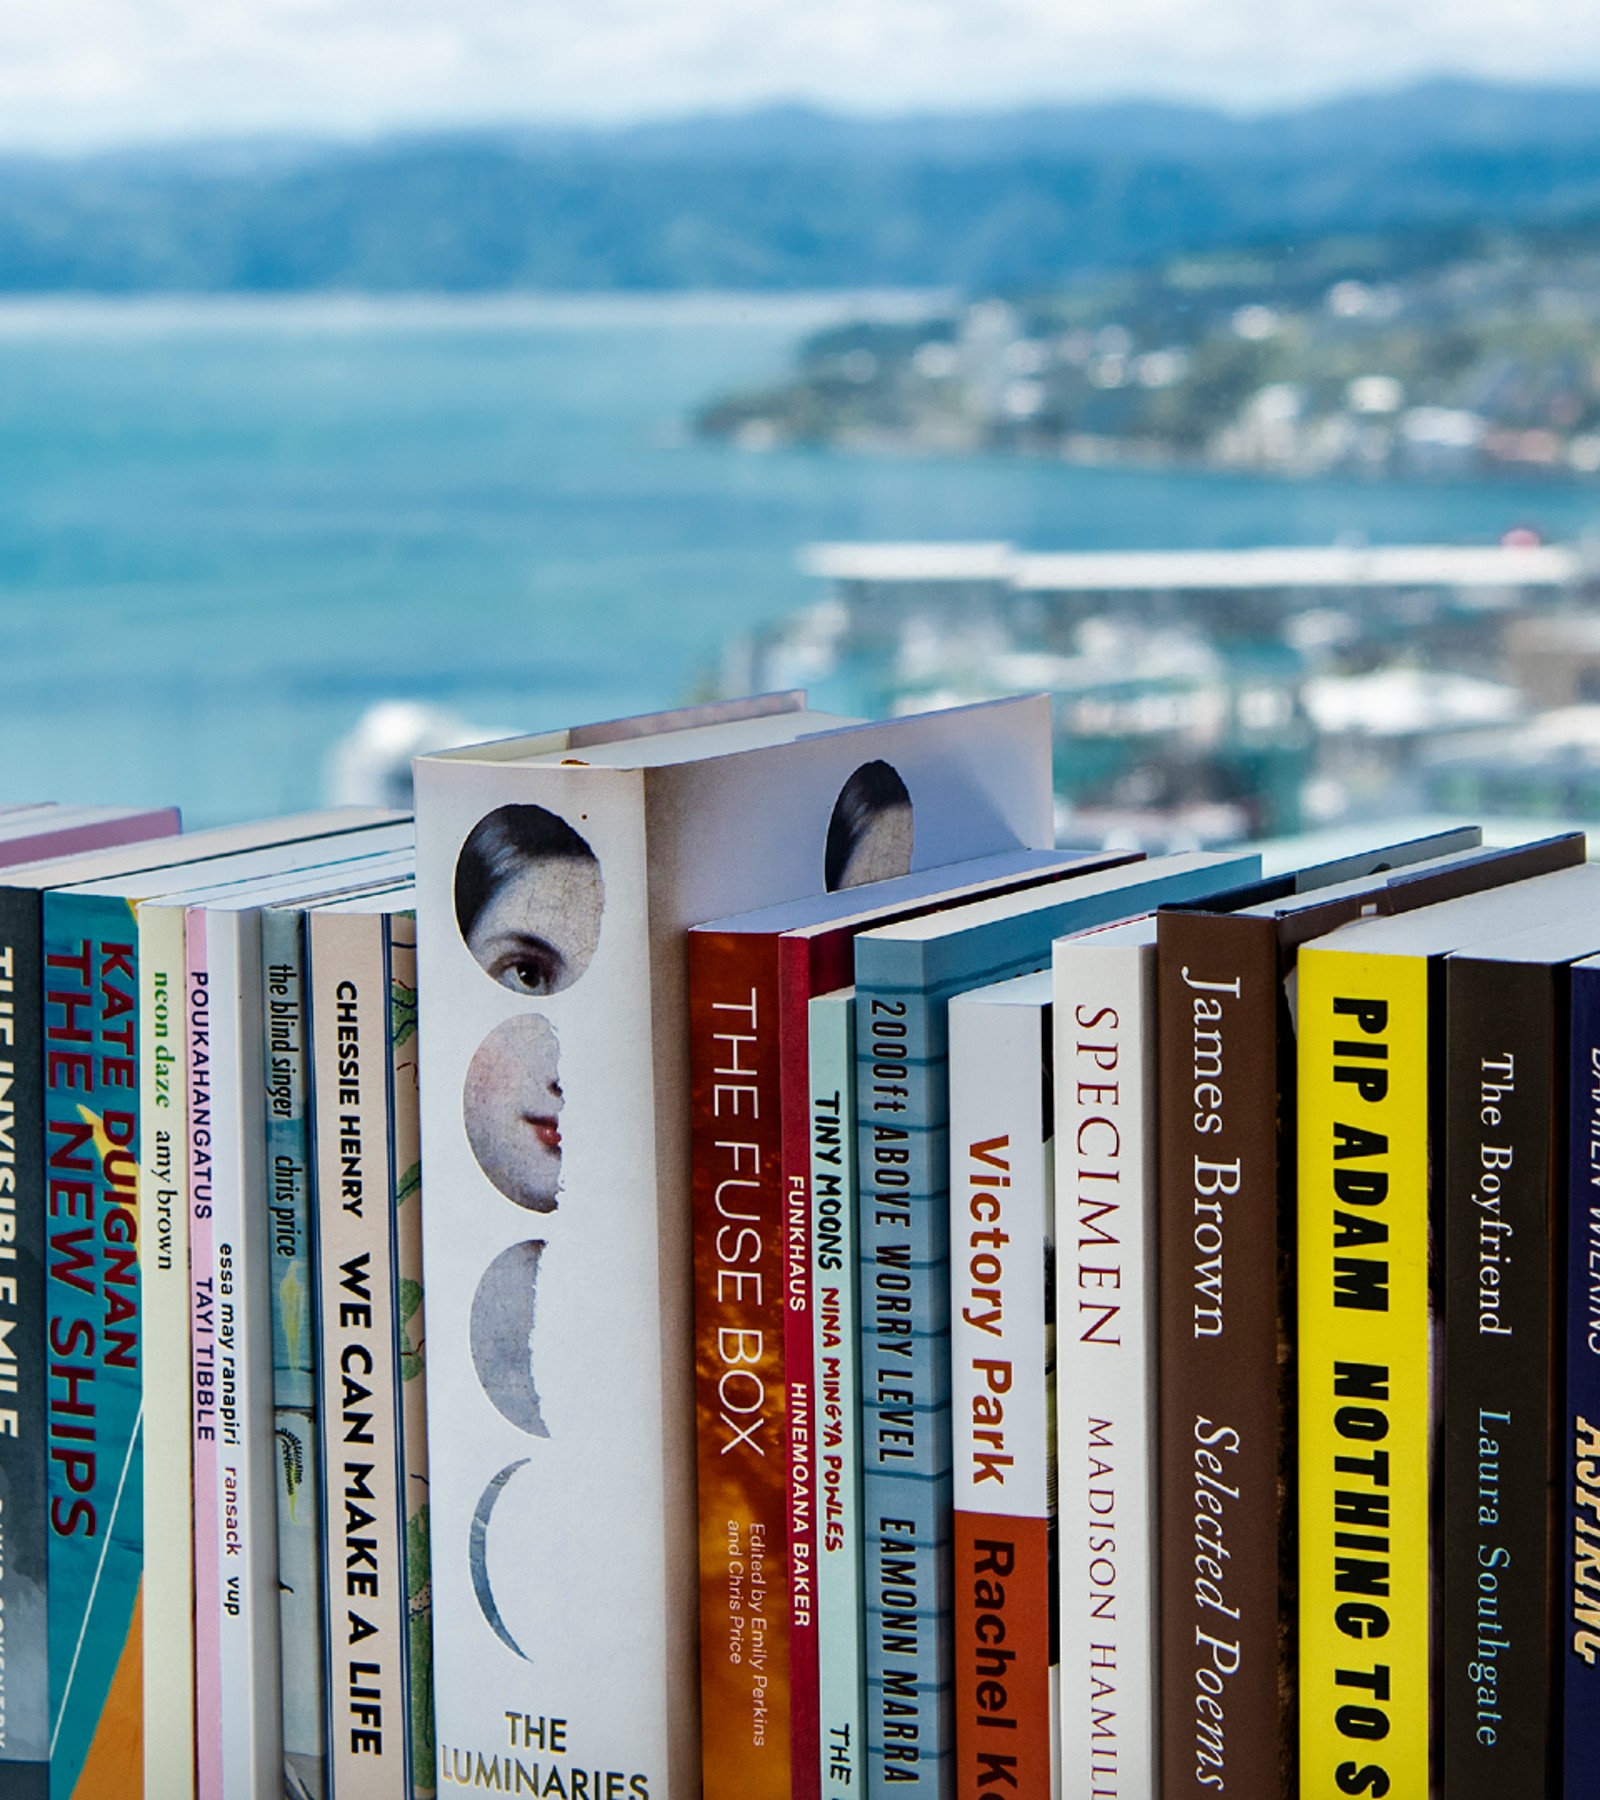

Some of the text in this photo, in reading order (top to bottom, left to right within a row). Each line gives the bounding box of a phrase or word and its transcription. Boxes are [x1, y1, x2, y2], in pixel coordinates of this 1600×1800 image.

[46, 939, 97, 1538] THE NEW SHIPS
[99, 941, 138, 1369] KATE DUIGNAN
[152, 972, 179, 1271] neon daze amy brown
[191, 972, 215, 1441] POUKAHANGATUS TAYI TIBBLE
[267, 964, 304, 1257] the blind singer chris price
[712, 987, 765, 1457] THE FUSE BOX
[1075, 1004, 1122, 1347] SPECIMEN
[218, 1244, 243, 1617] essa may ranapiri ransack vup
[336, 980, 383, 1757] CHESSIE HENRY WE CAN MAKE A LIFE
[727, 1520, 744, 1664] and Chris Price
[787, 1176, 811, 1628] FUNKHAUS HINEMOANA BAKER
[814, 1091, 851, 1787] TINY MOONS NINA MINGYA POWLES THE
[871, 1000, 920, 1785] 2000ft ABOVE WORRY LEVEL EAMONN MARRA
[962, 1134, 1018, 1800] Victory Park Rachel K
[1087, 1416, 1117, 1622] MADISON
[1181, 966, 1241, 1791] James Brown Selected Poems
[1333, 997, 1391, 1799] PIP ADAM NOTHING TO S
[1468, 1053, 1515, 1747] The Boyfriend Laura Southgate
[440, 1744, 650, 1800] LUMINARIES
[504, 1711, 568, 1754] THE
[748, 1522, 768, 1746] Edited by Emily Perkins
